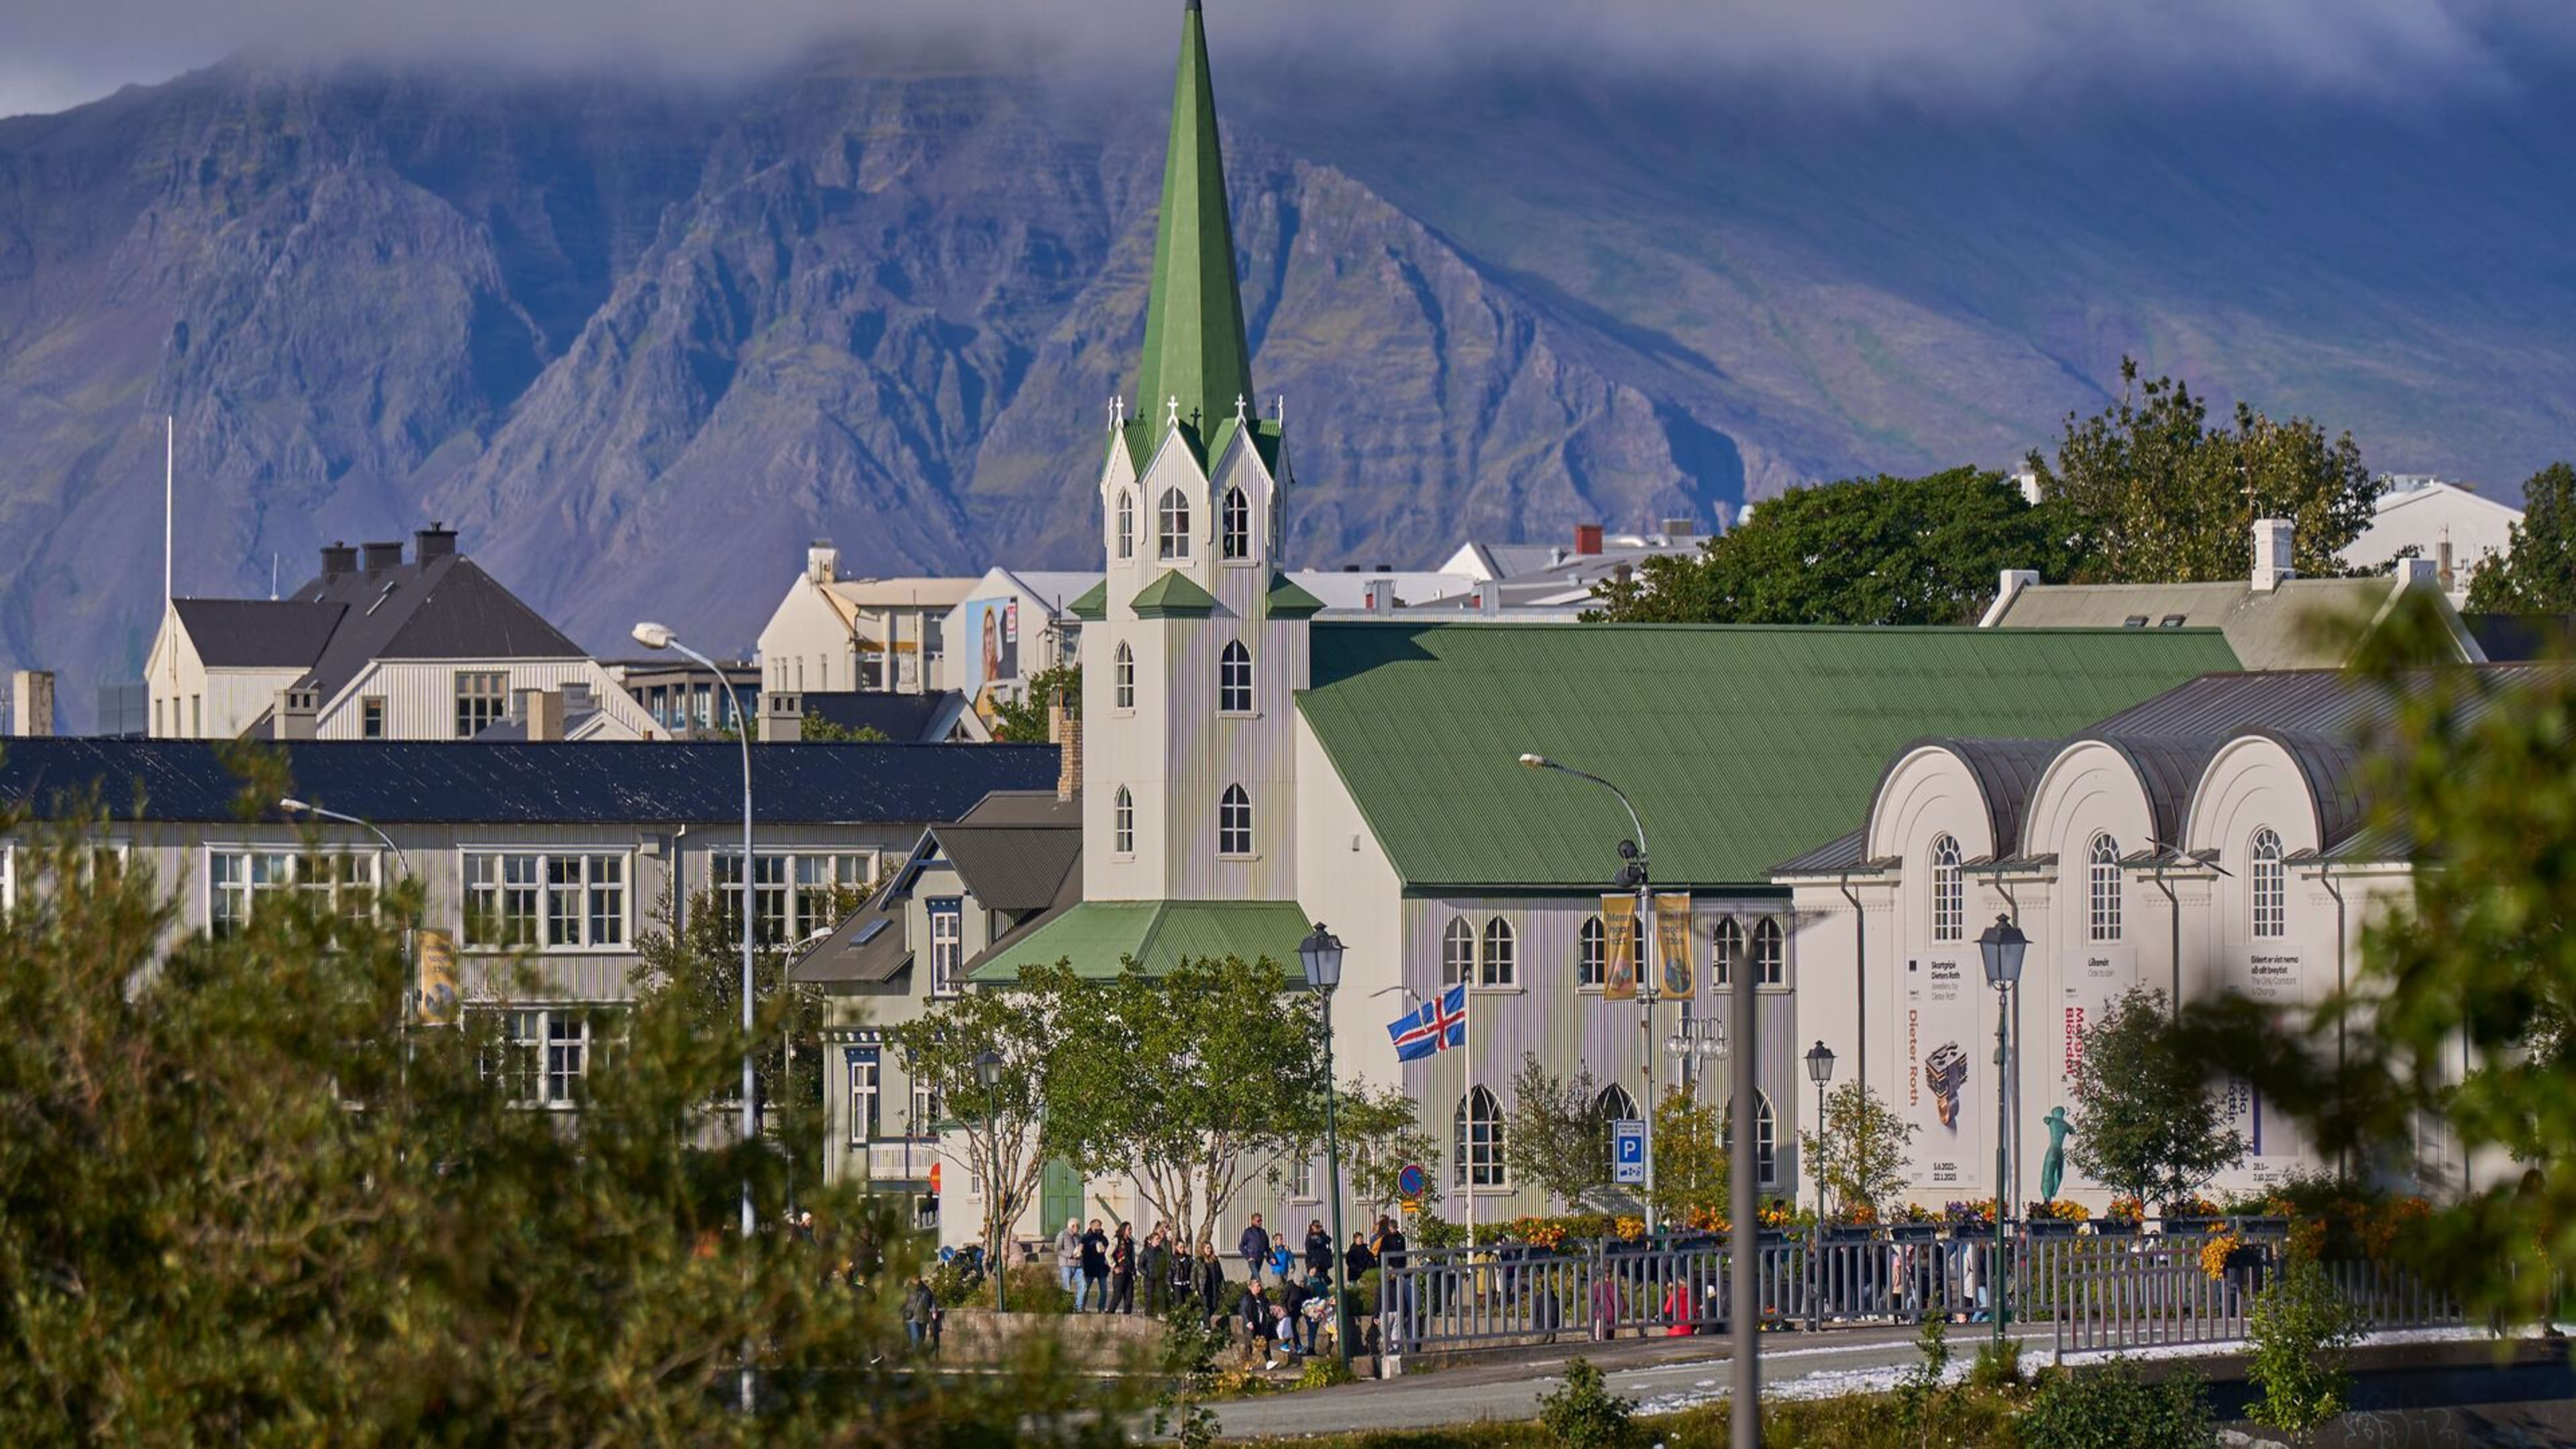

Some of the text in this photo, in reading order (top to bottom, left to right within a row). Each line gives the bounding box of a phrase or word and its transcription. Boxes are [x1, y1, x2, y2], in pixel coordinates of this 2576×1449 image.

[1910, 1010, 1918, 1063] Dieter
[2065, 1008, 2074, 1074] Blöndal
[1910, 1067, 1918, 1106] Roth
[1625, 1140, 1636, 1159] P
